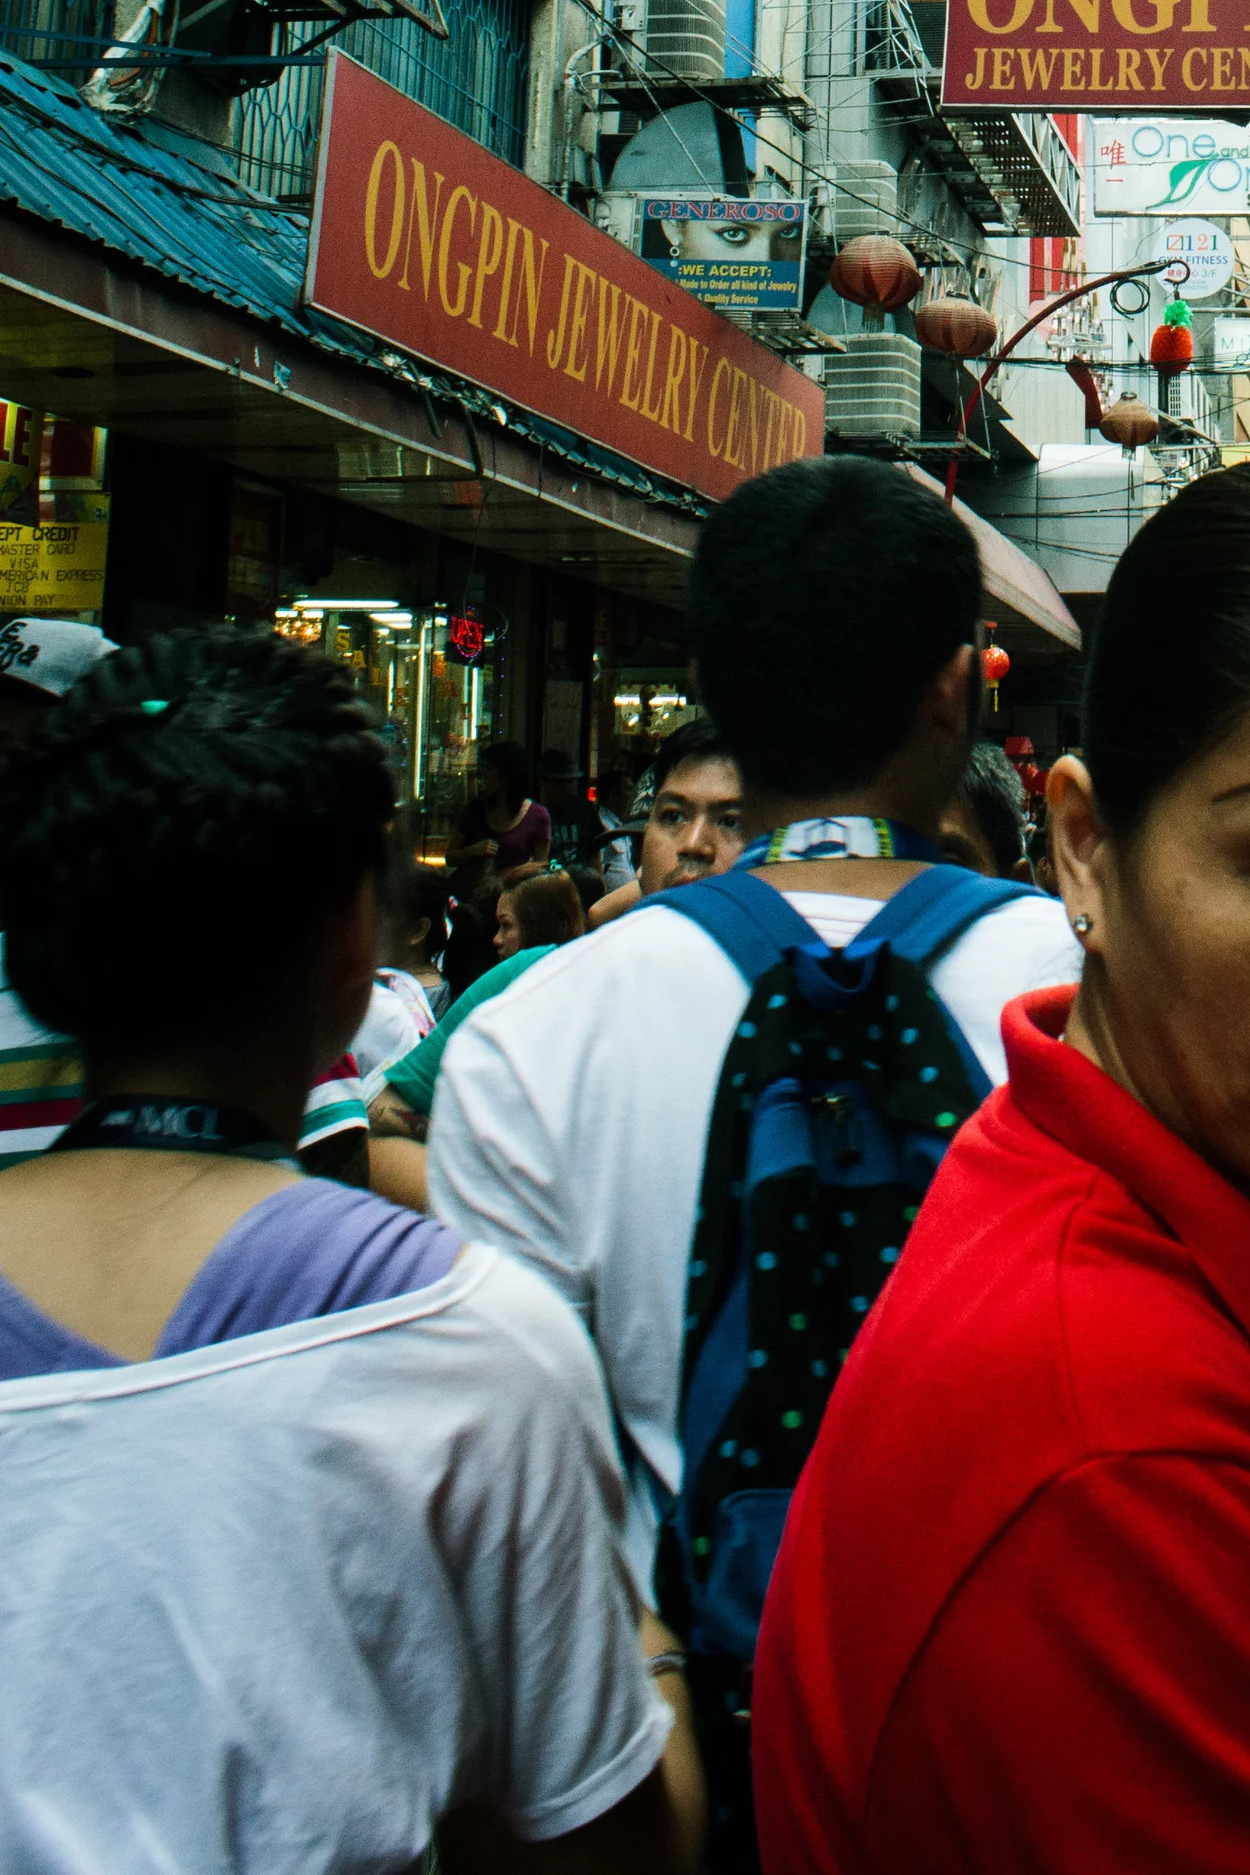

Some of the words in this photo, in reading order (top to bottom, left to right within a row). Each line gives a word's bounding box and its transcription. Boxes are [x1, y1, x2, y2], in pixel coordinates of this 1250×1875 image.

[965, 47, 1175, 92] JEWELRY
[1132, 125, 1216, 158] One
[1220, 145, 1250, 158] and
[1100, 139, 1127, 183] 唯一
[647, 200, 800, 222] GENEROSO
[1186, 256, 1228, 265] FITNESS
[700, 279, 708, 289] to
[709, 279, 730, 290] Order
[741, 279, 757, 291] kind
[768, 280, 797, 293] Jewelry
[704, 293, 729, 305] Quality
[731, 293, 759, 305] Service
[364, 139, 551, 361] ONGPIN
[547, 254, 709, 443] JEWELRY
[708, 356, 807, 475] CENTER
[33, 526, 80, 542] CREDIT
[47, 543, 76, 556] CARD
[10, 557, 39, 570] VISA
[56, 569, 104, 582] EXPRESS
[6, 581, 30, 594] JCB
[34, 594, 55, 606] PAY
